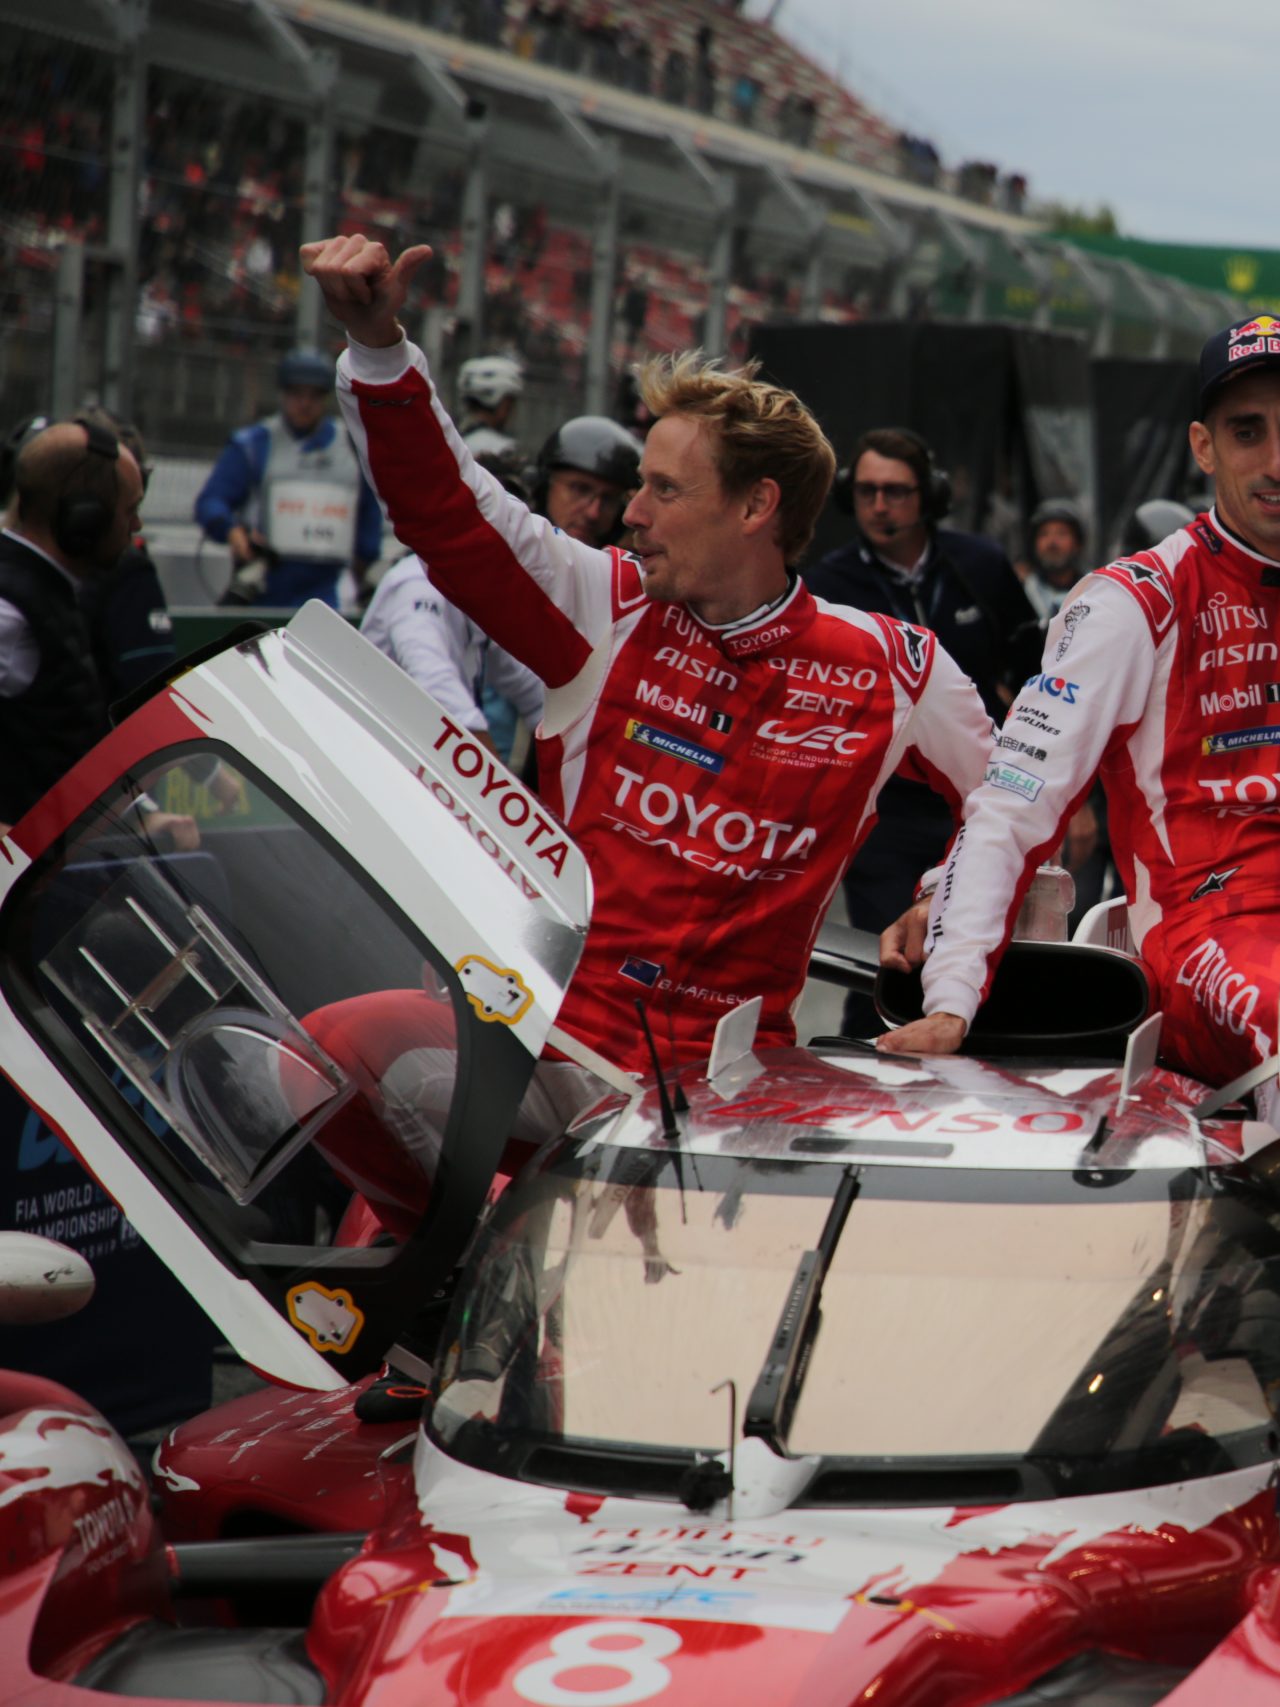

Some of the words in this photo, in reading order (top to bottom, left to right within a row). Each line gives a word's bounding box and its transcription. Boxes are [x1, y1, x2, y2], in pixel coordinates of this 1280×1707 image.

[1228, 337, 1265, 361] Red
[730, 624, 791, 650] TOYOTA
[768, 656, 877, 691] DENSO
[635, 679, 707, 725] Mobil
[784, 688, 854, 717] ZENT
[1016, 705, 1050, 721] JAPAN
[1200, 684, 1262, 717] Mobil
[652, 733, 716, 767] MICHELIN
[757, 719, 868, 755] WEC
[799, 753, 854, 769] ENDURANCE
[433, 716, 569, 878] TOYOTA
[614, 764, 818, 862] TOYOTA
[601, 813, 805, 881] RACING
[707, 1099, 1084, 1134] DENSO
[15, 1197, 39, 1223] FIA
[43, 1183, 93, 1217] WORLD
[573, 1560, 768, 1582] ZENT
[512, 1620, 683, 1707] 8
